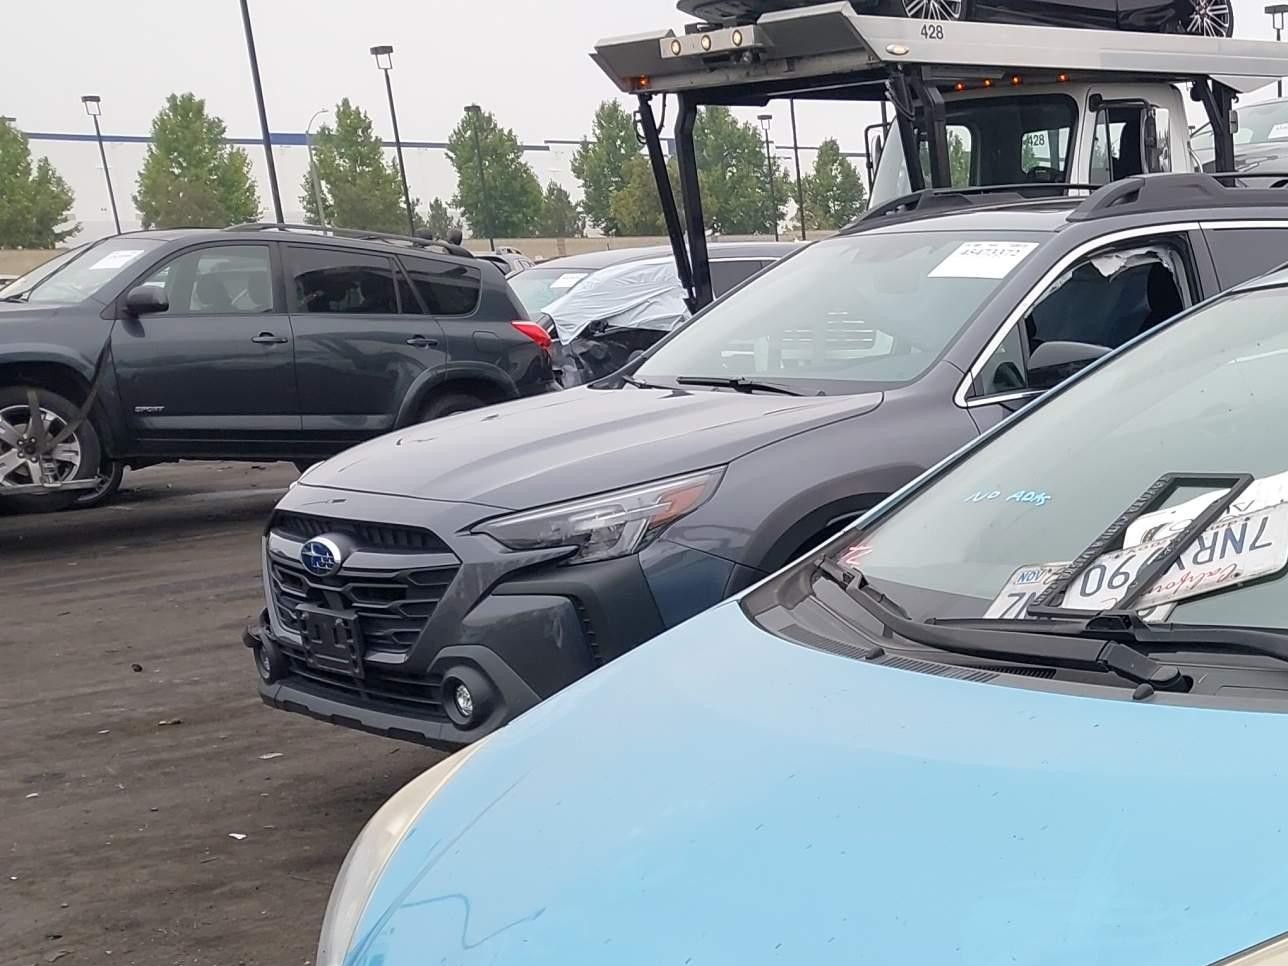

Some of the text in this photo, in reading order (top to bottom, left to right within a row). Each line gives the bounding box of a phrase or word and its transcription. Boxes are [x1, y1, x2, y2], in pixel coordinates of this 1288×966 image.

[920, 23, 944, 40] 428
[1027, 134, 1045, 146] 428
[1018, 570, 1042, 583] NOV
